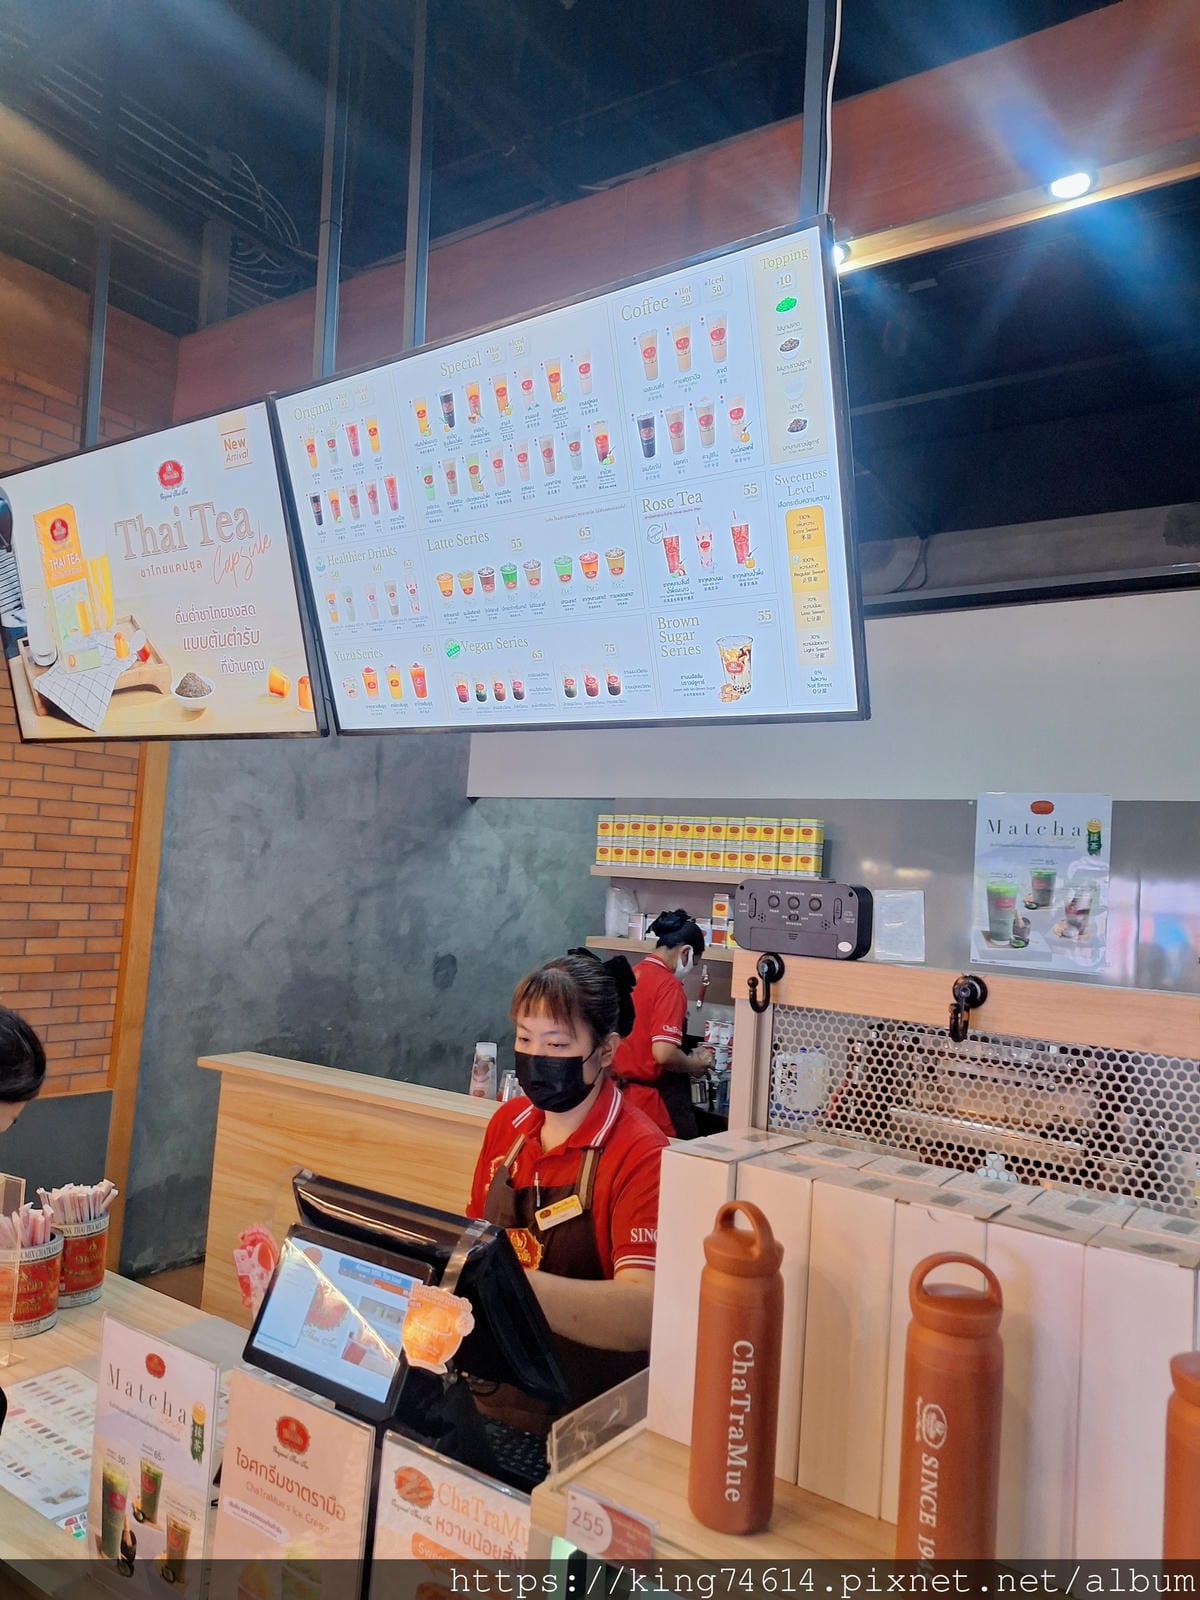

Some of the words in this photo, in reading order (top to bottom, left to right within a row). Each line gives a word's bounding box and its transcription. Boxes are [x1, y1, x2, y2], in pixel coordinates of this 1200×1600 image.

[760, 248, 809, 272] Topping
[712, 284, 722, 294] 50
[620, 296, 670, 321] Coffee
[681, 294, 691, 305] 50
[440, 352, 482, 379] Special
[294, 398, 334, 421] Original
[224, 437, 246, 452] New
[225, 449, 250, 464] Arrival
[774, 468, 828, 486] Sweetness
[641, 497, 674, 513] Rose
[676, 491, 703, 508] Tea
[743, 483, 758, 496] 55
[787, 482, 815, 498] Level
[114, 506, 188, 561] Thai
[188, 501, 254, 547] Tea
[579, 526, 591, 538] 65
[427, 538, 454, 552] Latte
[456, 530, 490, 547] Series
[511, 538, 522, 549] 55
[48, 555, 66, 571] THAI
[213, 519, 272, 588] Capsule
[327, 553, 366, 567] Healthier
[367, 546, 399, 561] Drinks
[140, 559, 203, 578] ชาไทยแคปซูล
[657, 616, 700, 630] Brown
[757, 609, 771, 622] 55
[183, 626, 260, 651] แบบต้นตำรับ
[460, 639, 493, 654] Vegan
[496, 635, 529, 650] Series
[604, 643, 615, 654] 75
[659, 630, 695, 647] Sugar
[334, 651, 356, 662] Yuzu
[357, 649, 384, 661] Series
[532, 650, 543, 659] 65
[660, 642, 702, 658] Series
[221, 655, 265, 676] ที่บ้านคุณ
[988, 818, 1080, 836] Matcha
[107, 1363, 187, 1425] Matcha
[725, 1339, 755, 1503] ChaTraMue
[236, 1446, 346, 1521] ไอศกรีมชาตรามือ
[919, 1452, 940, 1528] SINCE
[571, 1506, 604, 1536] 255
